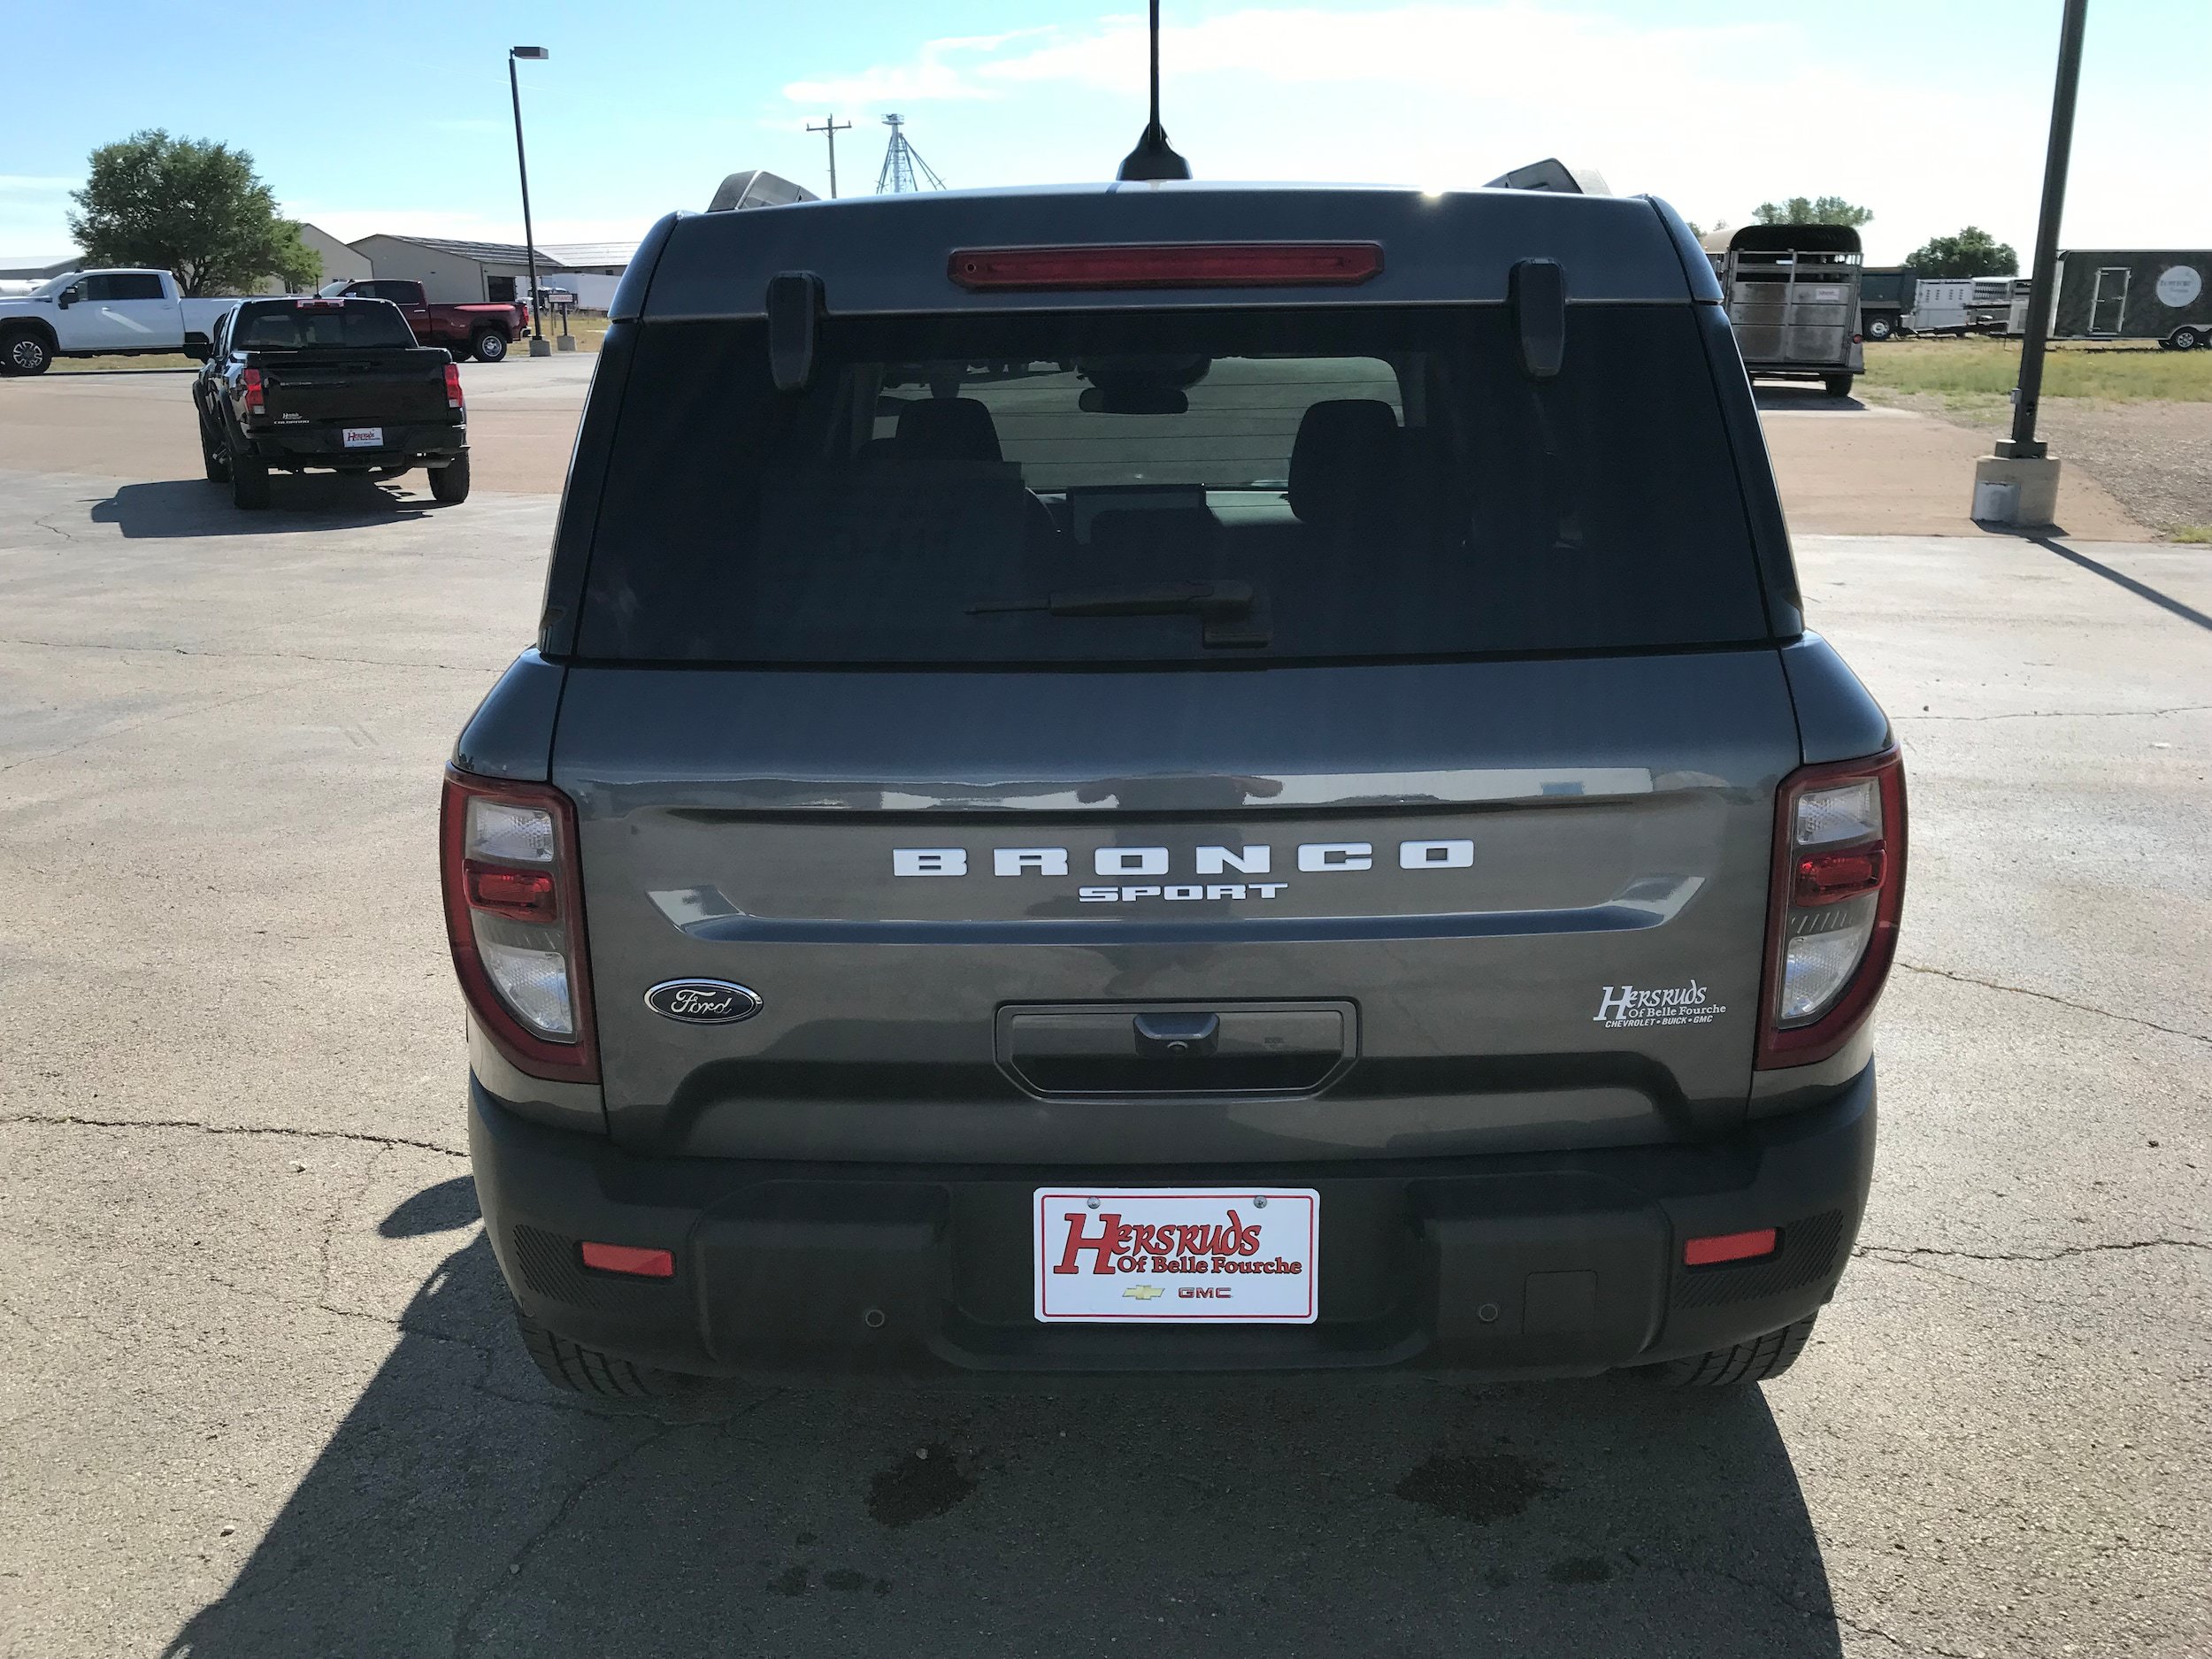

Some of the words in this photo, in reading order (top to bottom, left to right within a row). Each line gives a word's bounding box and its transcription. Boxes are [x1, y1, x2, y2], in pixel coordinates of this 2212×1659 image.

[892, 839, 1475, 877] BRONCO
[1079, 882, 1289, 902] SPORT
[670, 989, 733, 1015] Ford
[1628, 1008, 1646, 1018] Of
[1647, 1006, 1678, 1018] Belle
[1678, 1004, 1726, 1016] Fourche
[1605, 1018, 1655, 1028] CHEVROLET
[1661, 1017, 1687, 1025] BUICK
[1693, 1015, 1713, 1025] GMC
[1117, 1255, 1148, 1274] Of
[1152, 1256, 1209, 1274] Belle
[1211, 1256, 1302, 1275] Fourche
[1178, 1287, 1233, 1299] GMC
